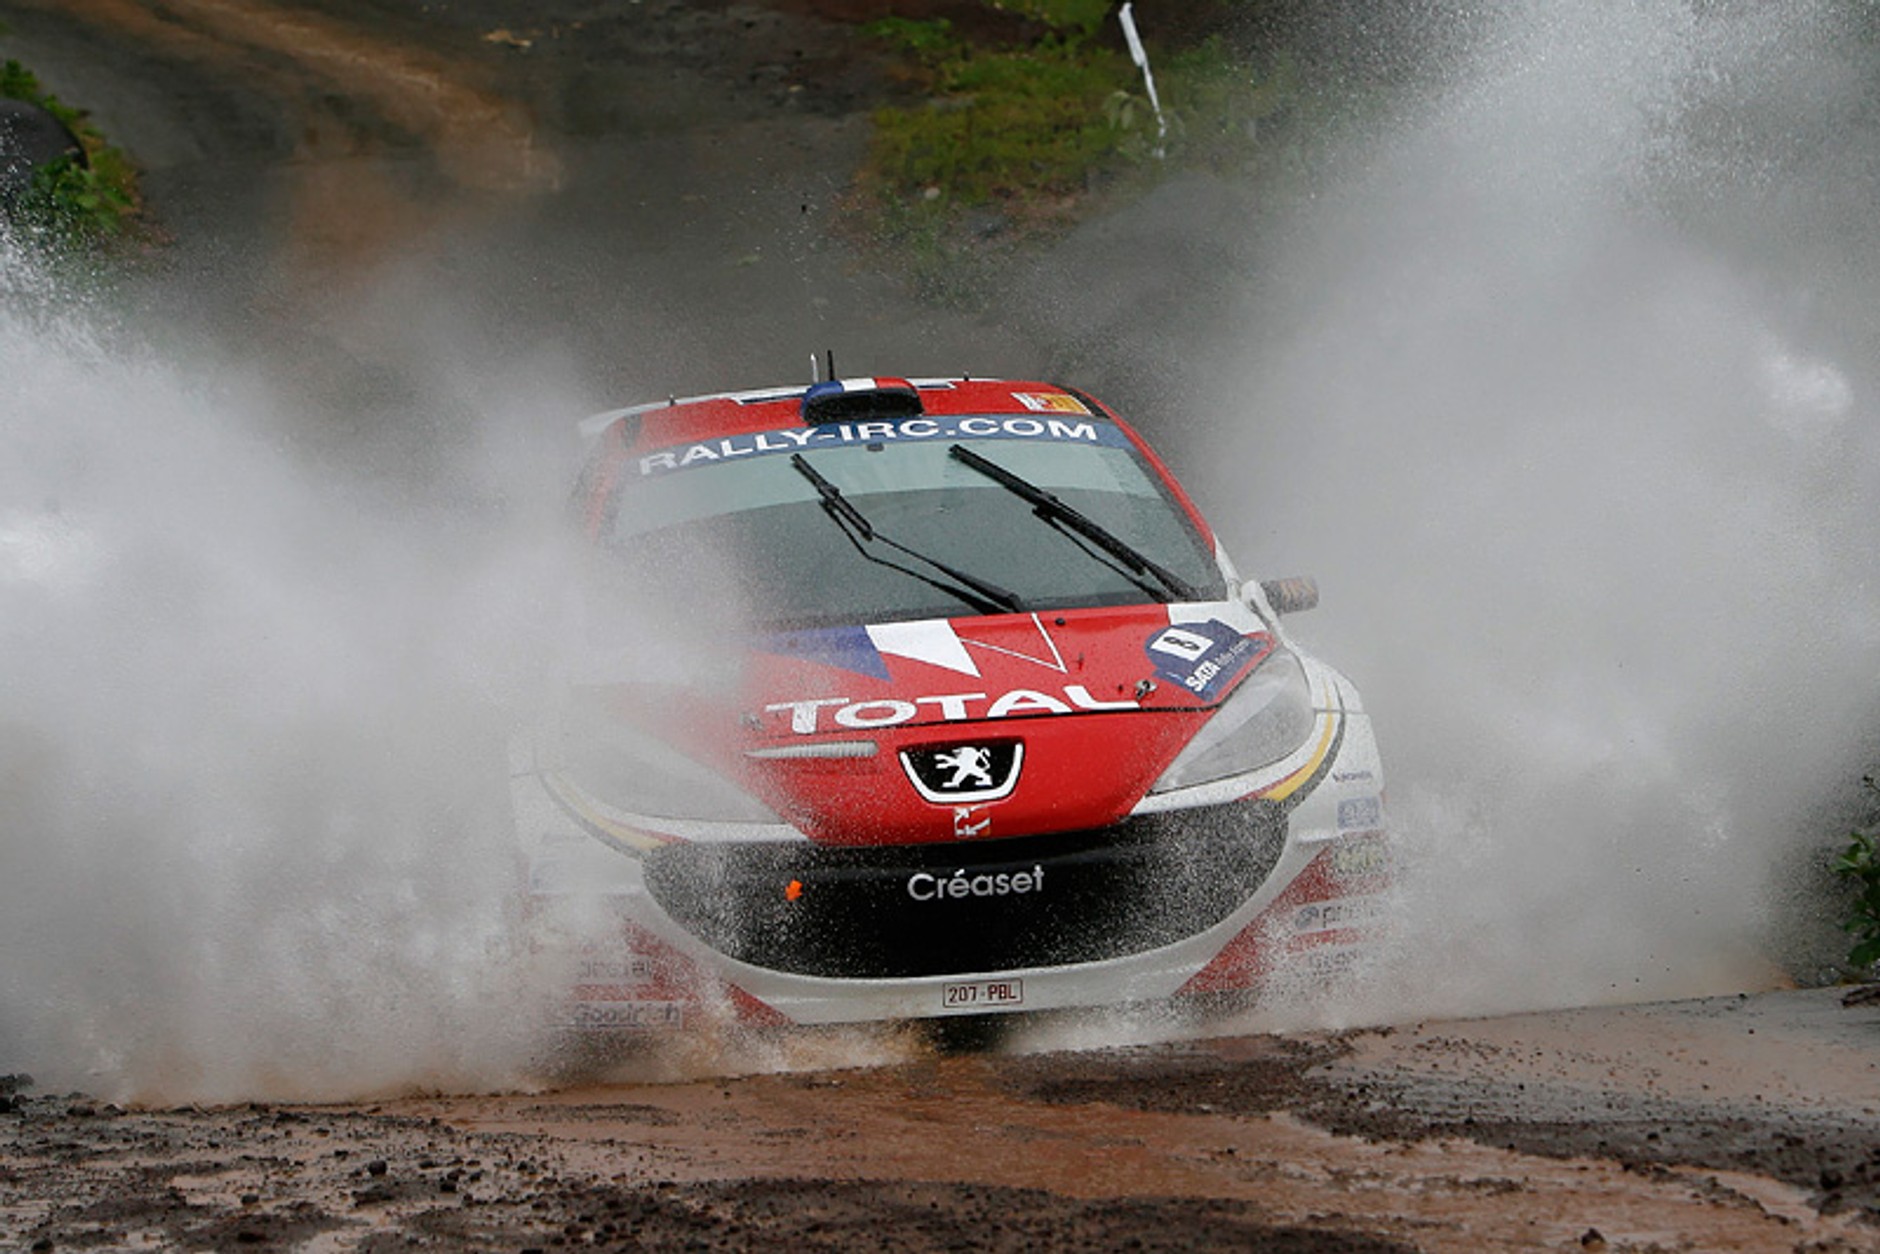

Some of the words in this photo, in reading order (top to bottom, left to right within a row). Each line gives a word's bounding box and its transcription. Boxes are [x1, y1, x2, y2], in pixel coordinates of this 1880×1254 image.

[639, 416, 1098, 475] RALLY-IRC.COM
[1162, 635, 1201, 652] 8
[1184, 660, 1221, 692] SATA
[766, 685, 1141, 735] TOTAL
[907, 864, 1045, 901] Créaset
